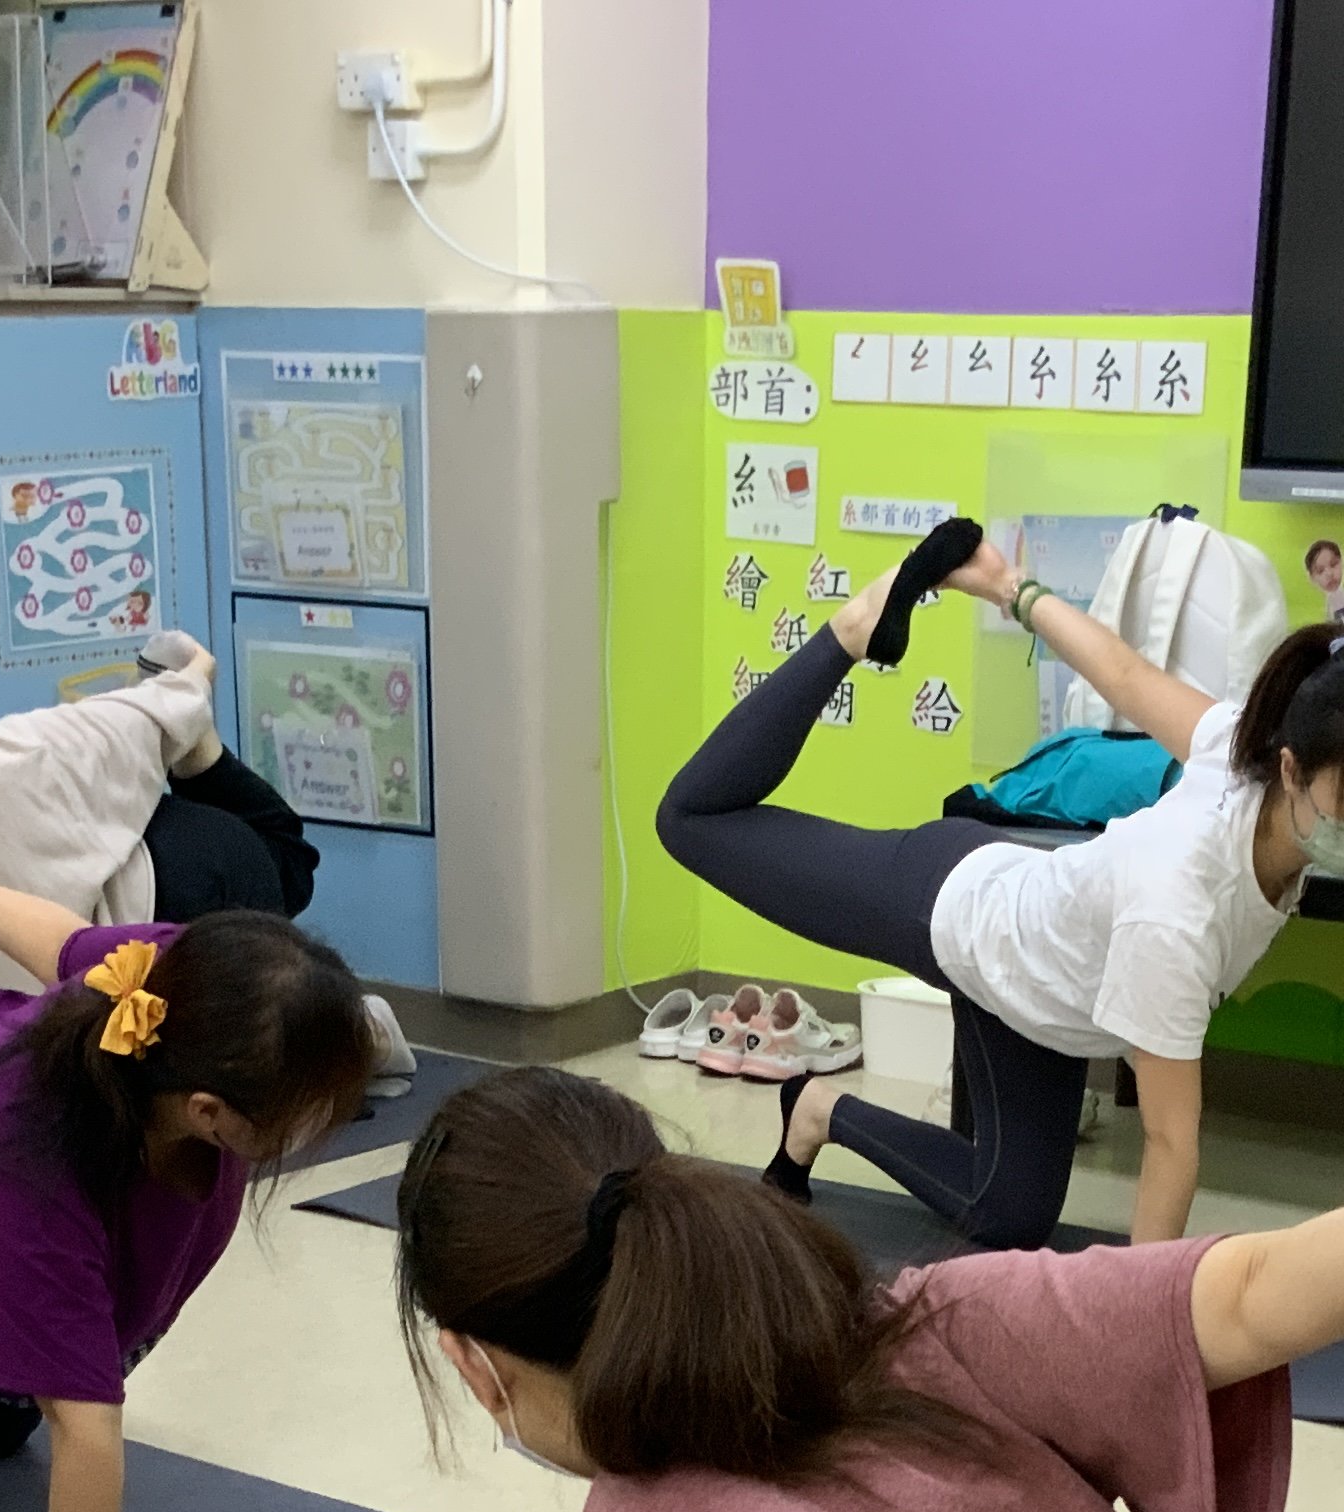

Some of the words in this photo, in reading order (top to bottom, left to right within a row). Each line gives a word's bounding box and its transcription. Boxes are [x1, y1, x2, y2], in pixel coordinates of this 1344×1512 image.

[110, 367, 197, 396] Letterland
[724, 555, 769, 610] 繪
[807, 553, 849, 599] 紅
[771, 607, 808, 651] 紙
[912, 681, 961, 732] 給
